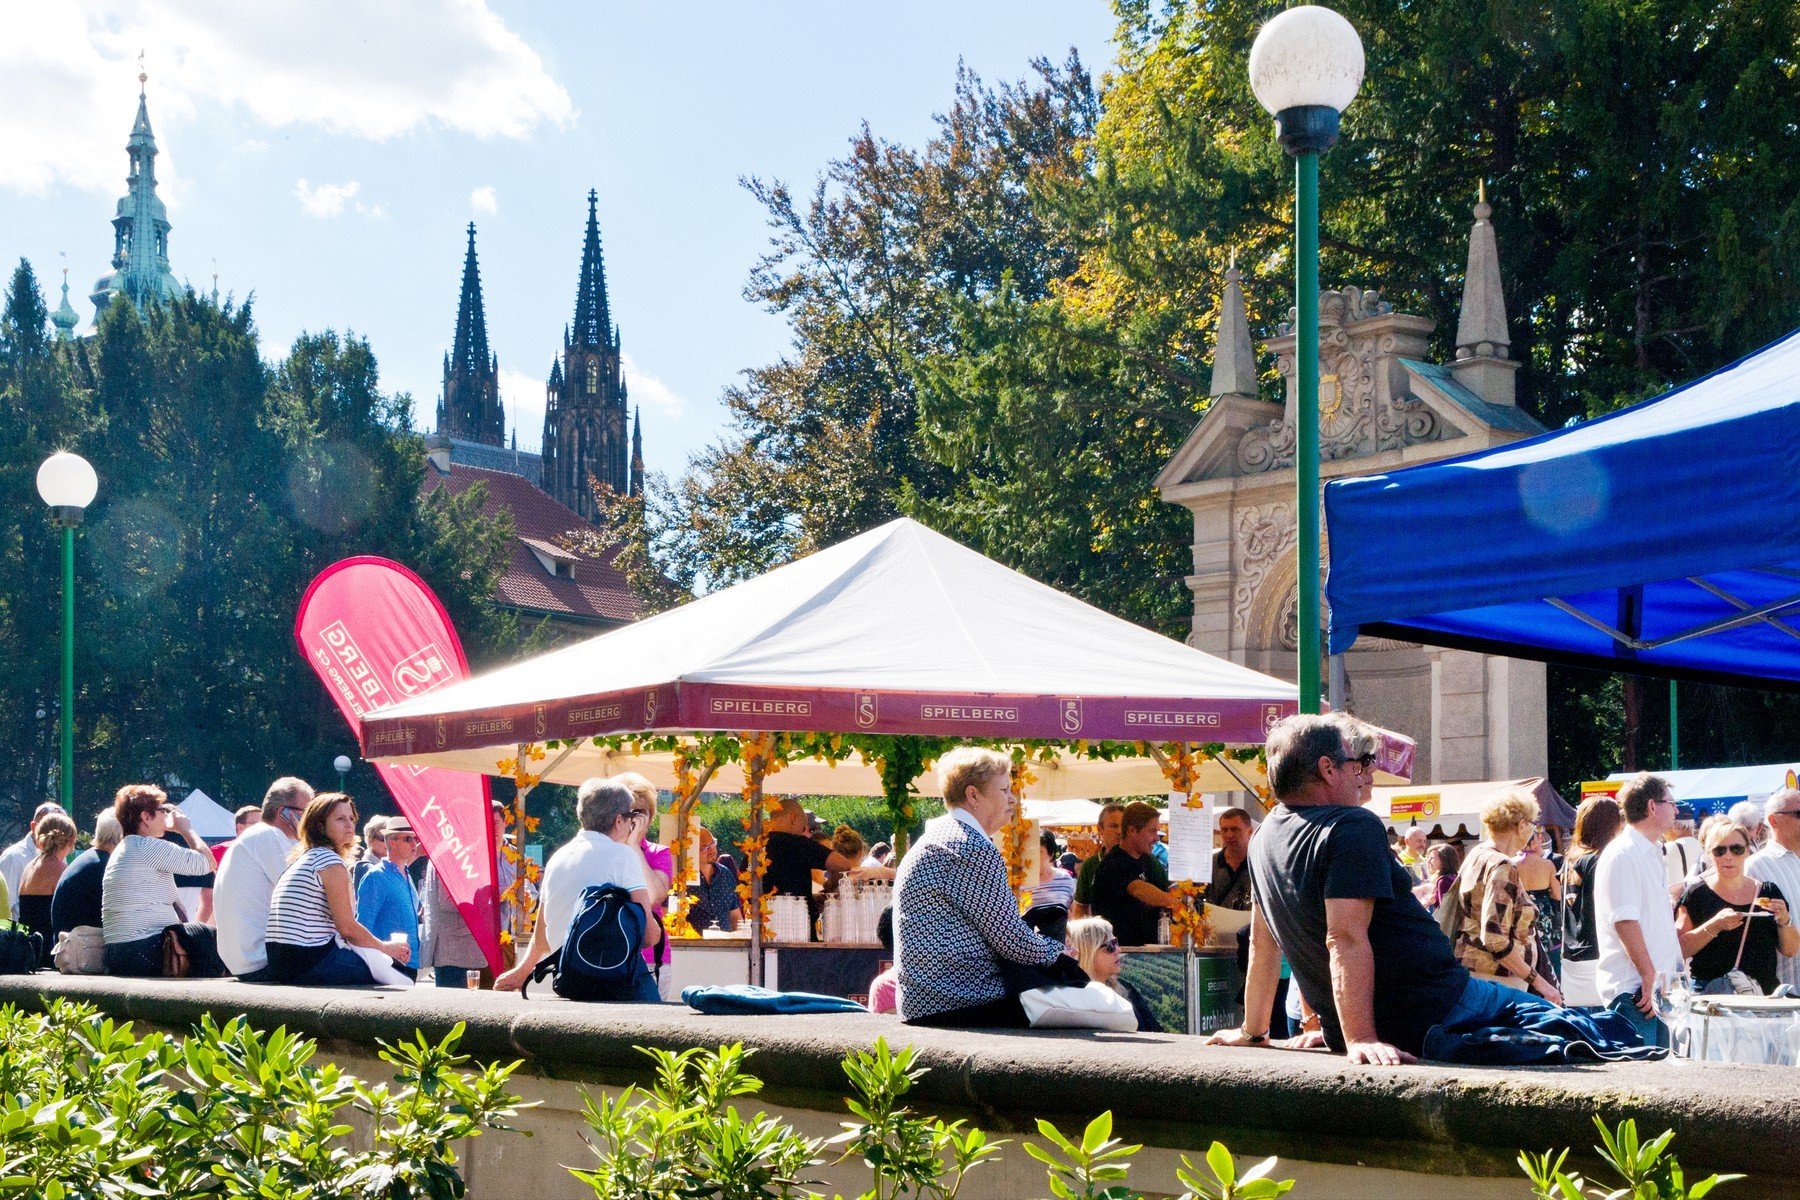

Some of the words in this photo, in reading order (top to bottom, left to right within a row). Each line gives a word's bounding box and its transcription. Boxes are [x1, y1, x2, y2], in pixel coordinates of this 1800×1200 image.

[374, 730, 415, 743] SPIELBERG
[437, 726, 446, 745] S
[466, 720, 512, 734] SPIELBERG
[536, 715, 545, 735] S
[569, 706, 621, 723] SPIELBERG
[645, 700, 656, 722] S
[713, 700, 809, 714] SPIELBERG
[859, 703, 875, 725] S
[923, 707, 1016, 720] SPIELBERG
[1064, 709, 1080, 731] S
[1127, 712, 1218, 725] SPIELBERG
